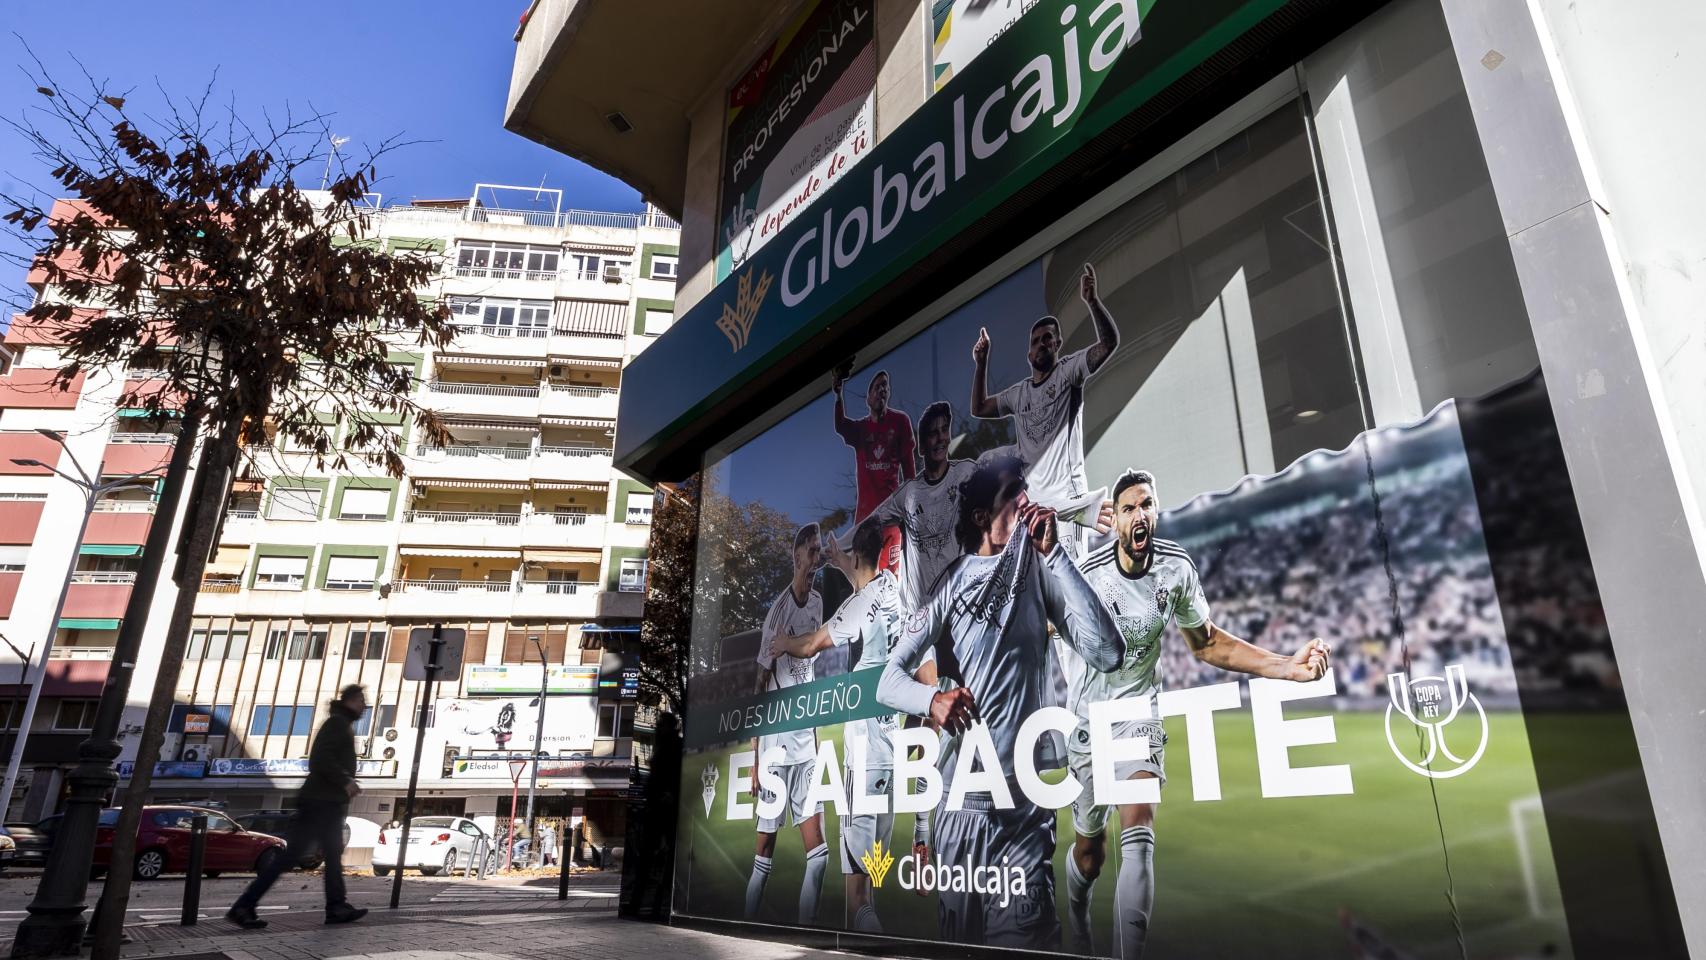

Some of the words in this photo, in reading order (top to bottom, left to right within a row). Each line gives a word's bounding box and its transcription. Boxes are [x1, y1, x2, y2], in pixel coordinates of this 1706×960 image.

[986, 17, 1016, 47] COACH
[733, 6, 869, 184] PROFESIONAL
[780, 0, 1143, 308] Globalcaja
[810, 143, 822, 158] de
[824, 133, 834, 144] tu
[760, 175, 823, 238] depende
[827, 152, 848, 180] de
[851, 130, 870, 156] ti
[718, 709, 742, 734] NO
[744, 704, 764, 730] ES
[767, 698, 792, 725] UN
[795, 681, 862, 719] SUEÑO
[1415, 685, 1441, 703] COPA
[1423, 704, 1439, 718] REY
[469, 761, 499, 771] Eledsol
[726, 746, 787, 821] ES
[802, 669, 1355, 816] ALBACETE
[898, 853, 1027, 908] Globalcaja
